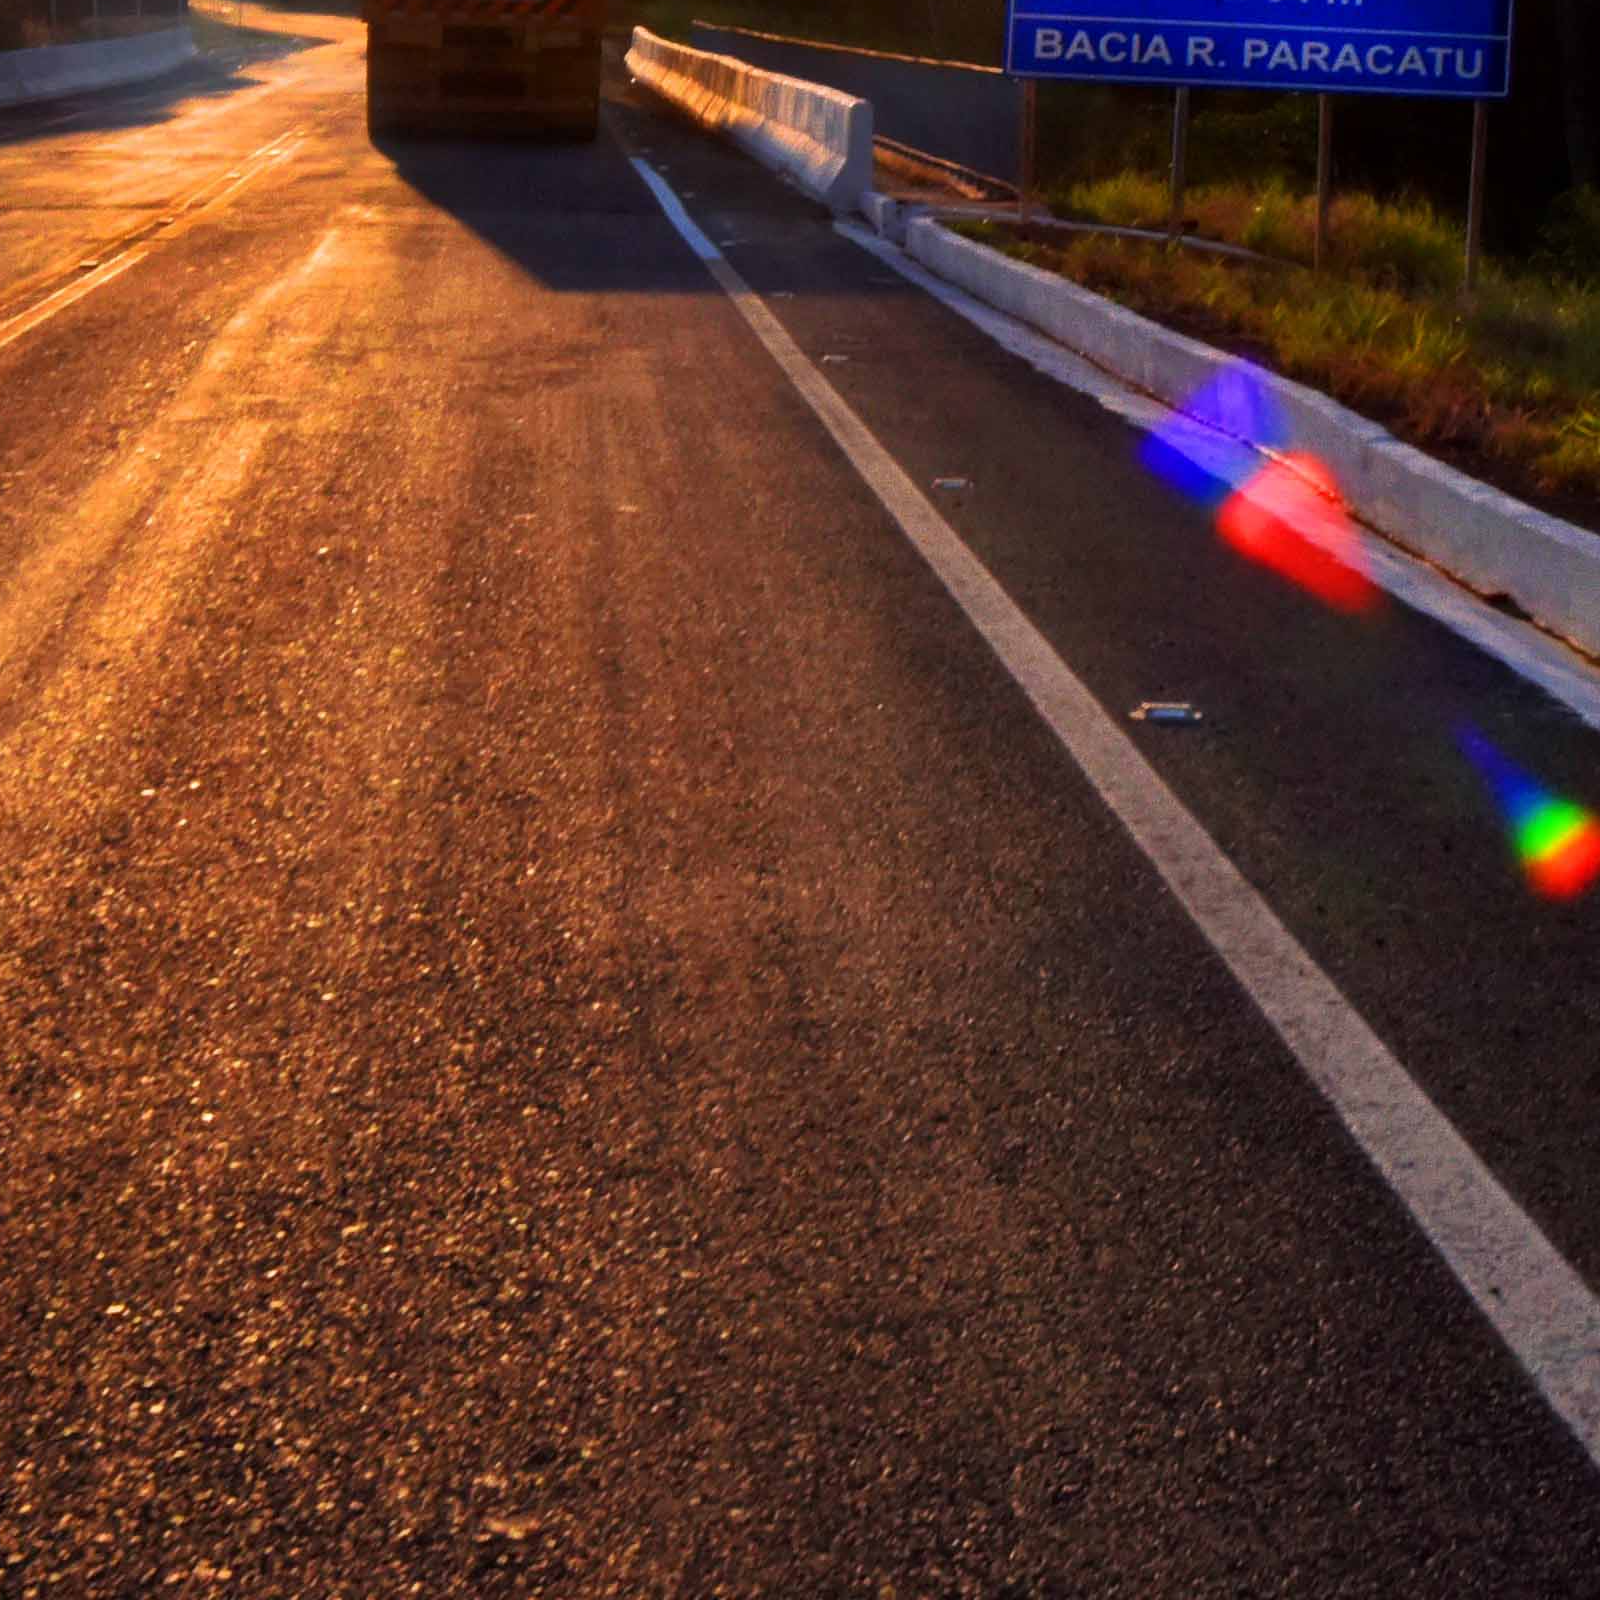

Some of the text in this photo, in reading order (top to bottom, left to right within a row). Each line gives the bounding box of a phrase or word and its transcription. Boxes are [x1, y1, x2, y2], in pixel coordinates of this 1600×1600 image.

[1034, 28, 1484, 79] BACIA R. PARACATU
